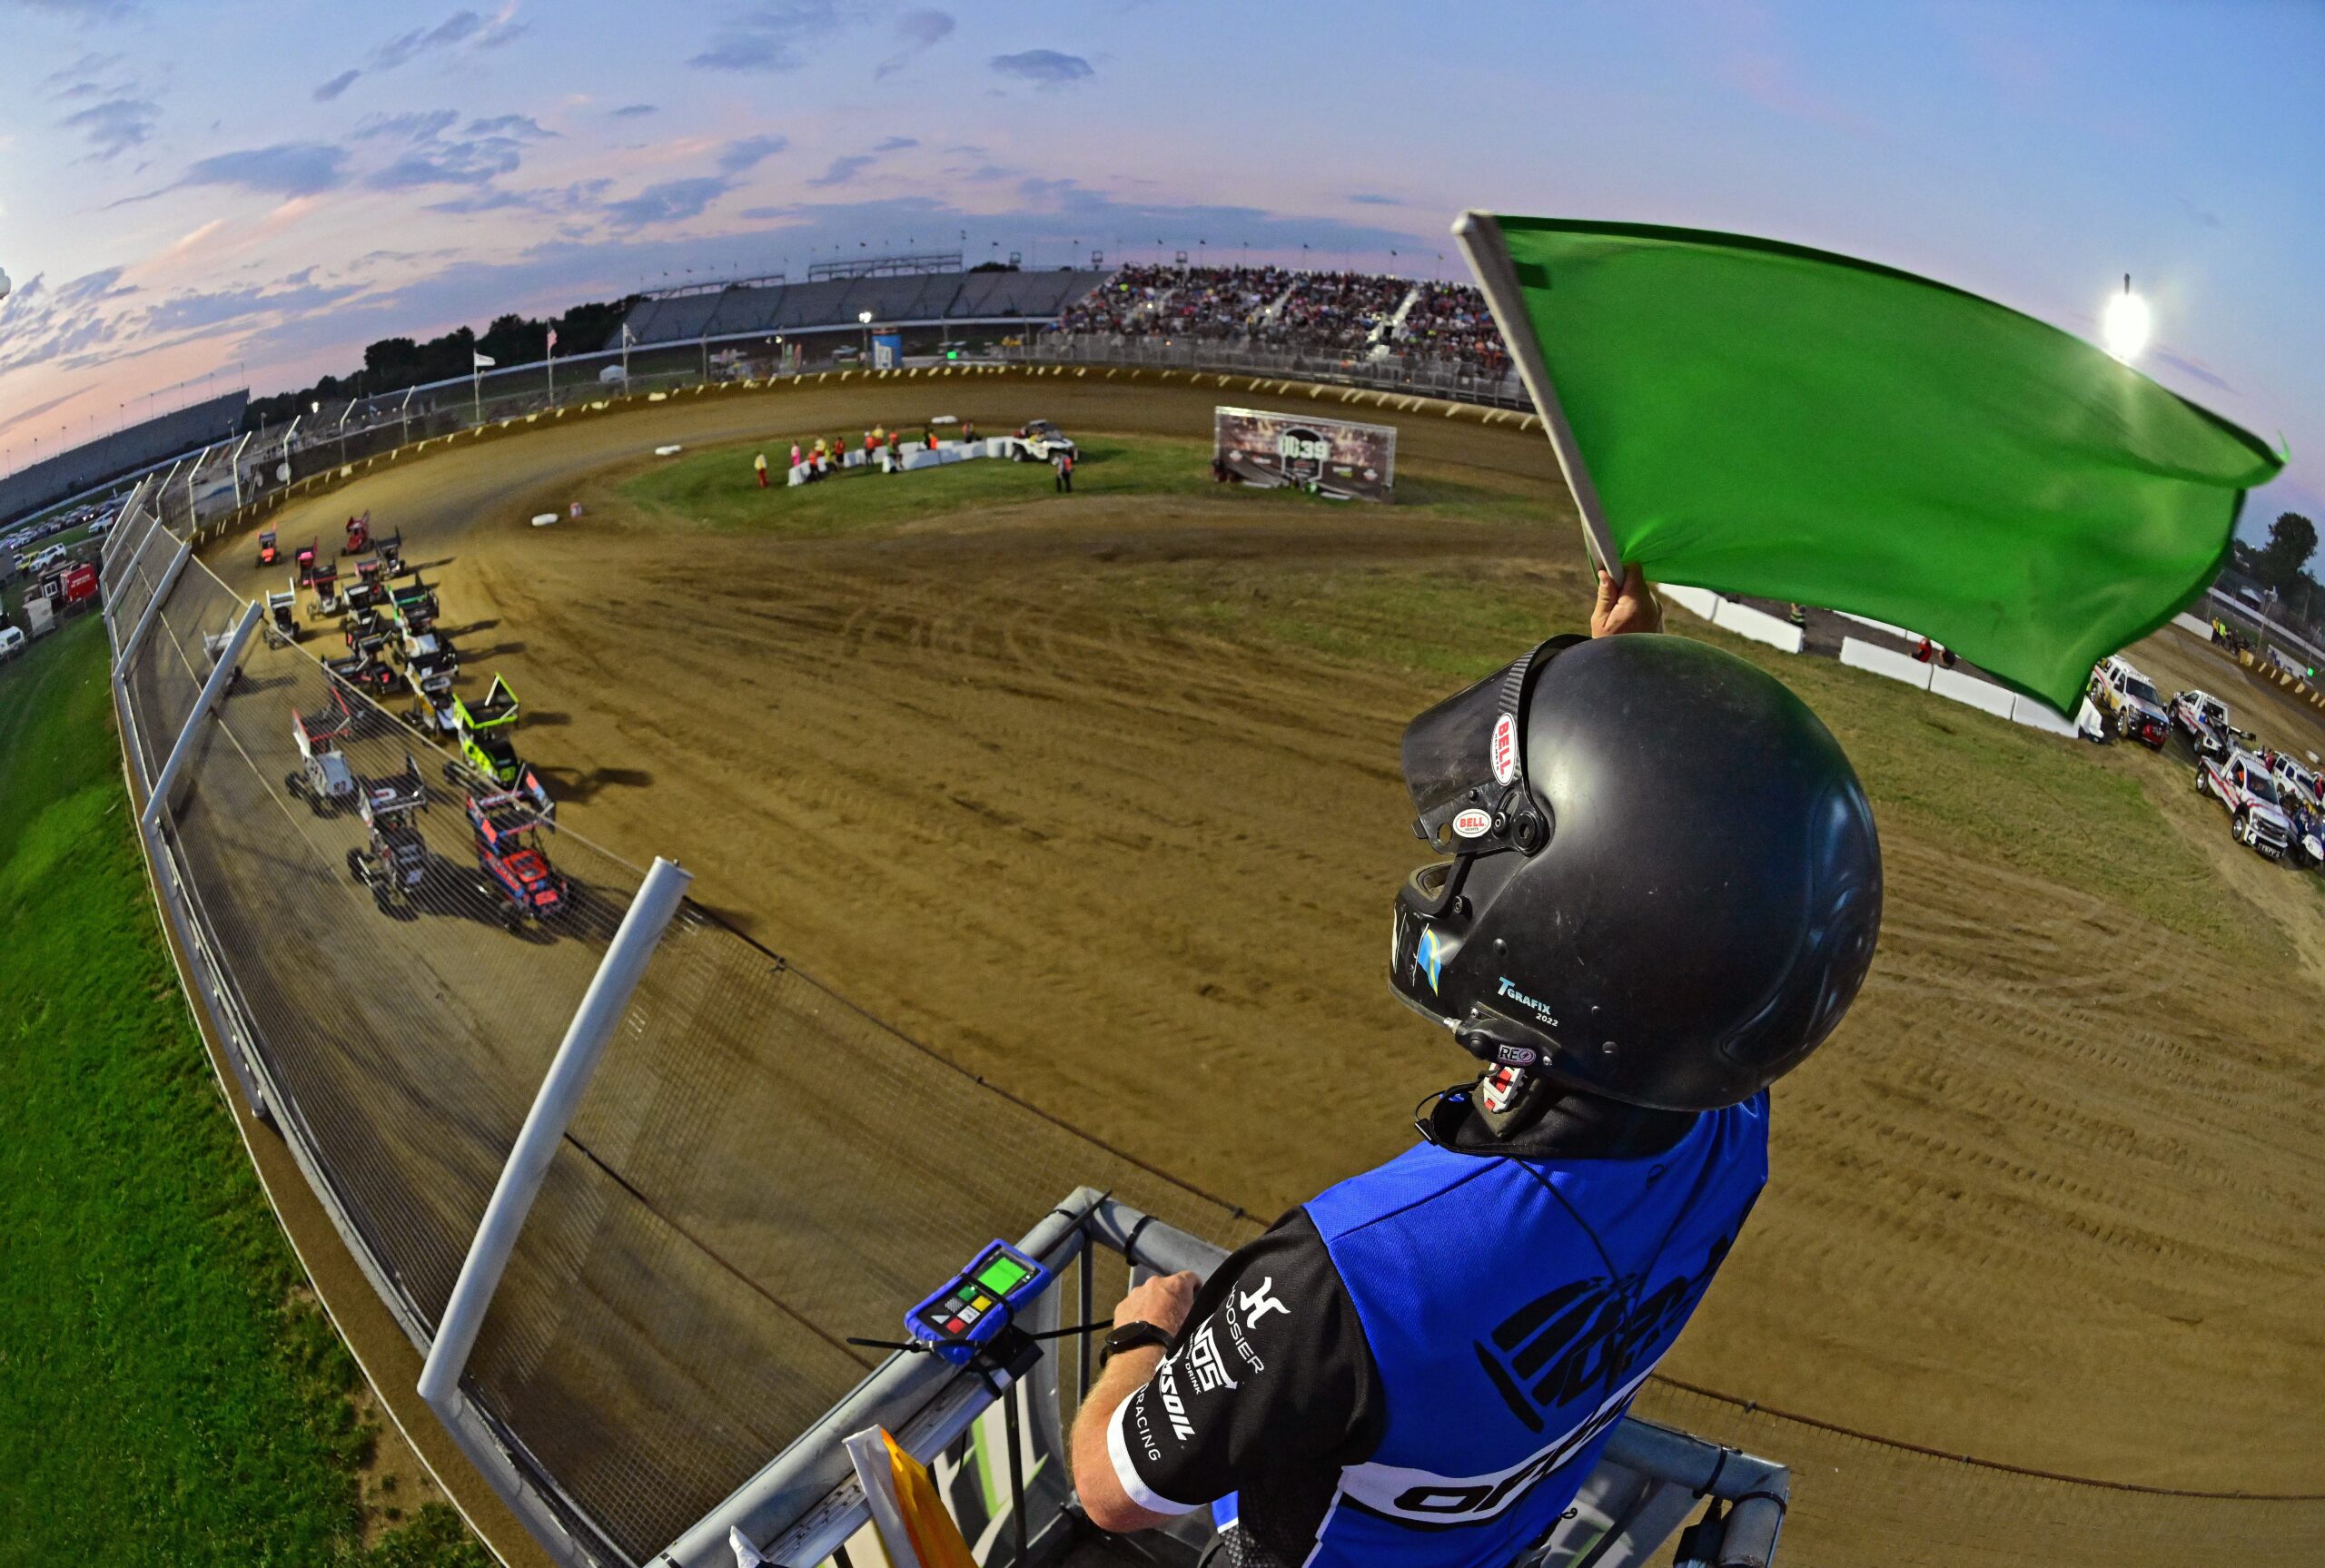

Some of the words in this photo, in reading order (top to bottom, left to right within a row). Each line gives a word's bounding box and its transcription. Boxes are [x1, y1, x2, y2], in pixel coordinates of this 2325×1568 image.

[1498, 720, 1511, 777] BELL
[1459, 816, 1485, 827] BELL
[1496, 976, 1551, 1016] TGRAFIX
[1535, 1012, 1559, 1028] 2022
[1184, 1363, 1202, 1395] DRINK
